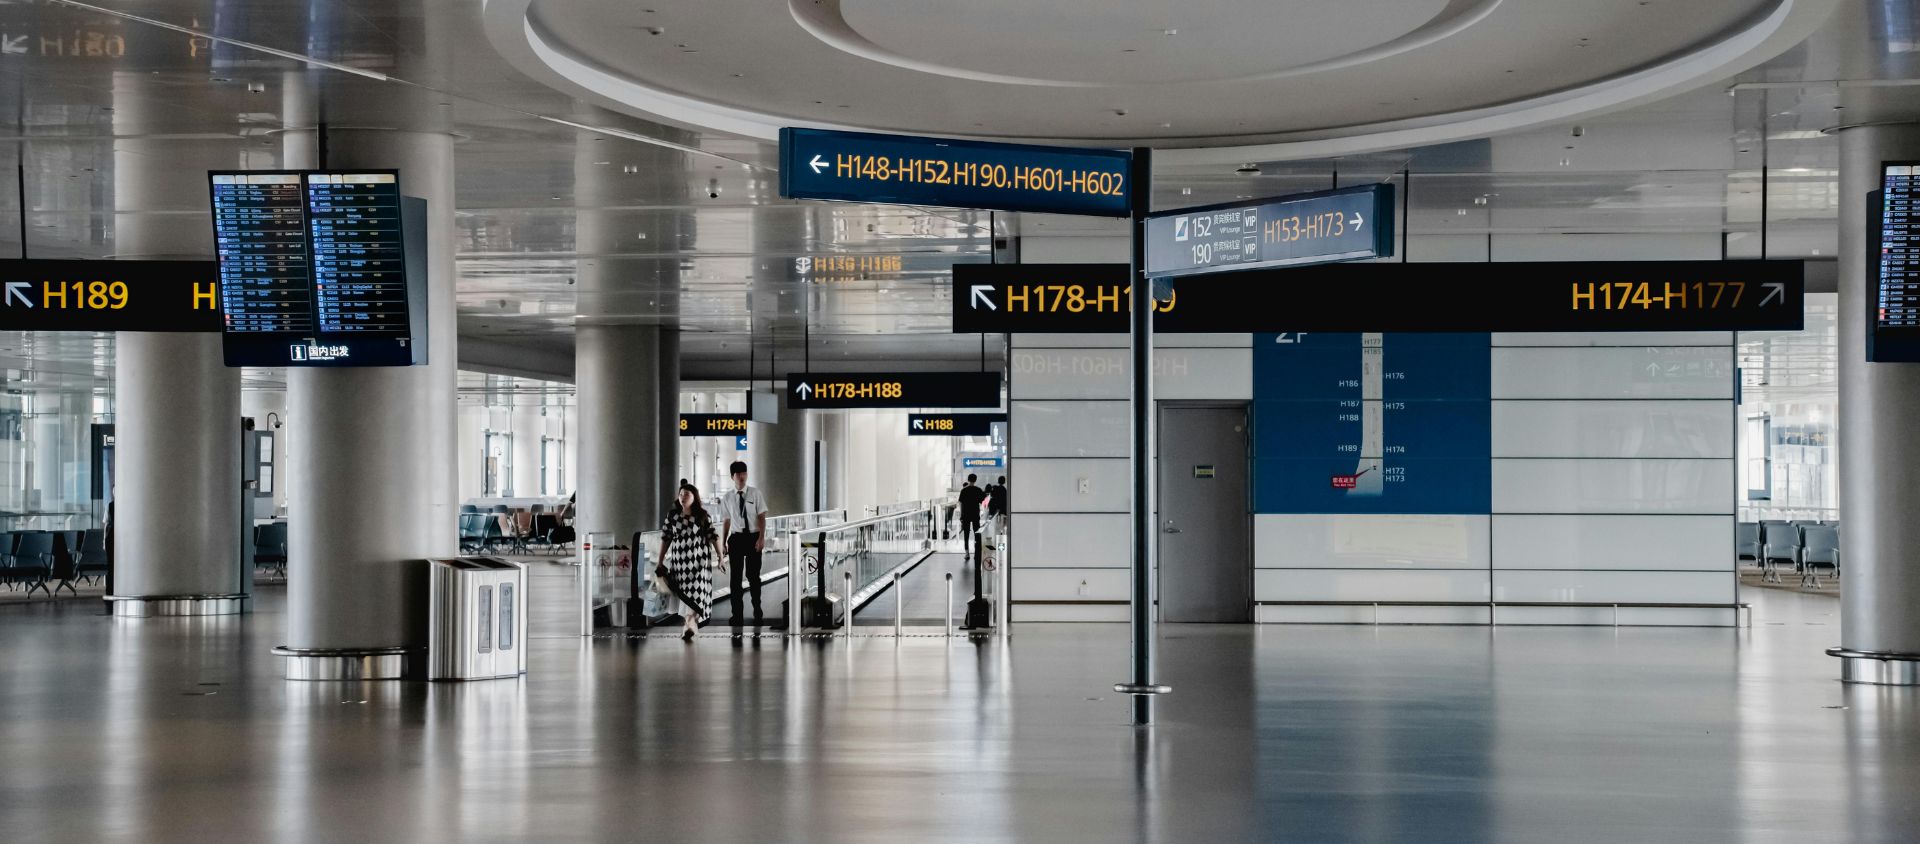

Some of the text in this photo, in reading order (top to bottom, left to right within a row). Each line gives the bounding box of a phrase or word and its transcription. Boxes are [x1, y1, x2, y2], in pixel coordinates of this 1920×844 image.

[1192, 216, 1211, 238] 152
[1245, 216, 1256, 227] VIP
[1264, 212, 1344, 244] H153-H173
[1192, 243, 1211, 265] 190
[1245, 243, 1256, 255] VIP
[43, 281, 129, 309] H189
[1007, 285, 1176, 313] H178-H19
[1572, 282, 1746, 310] H174-H177
[309, 345, 349, 357] 国内出发
[814, 382, 902, 398] H178-H188
[925, 419, 954, 430] H188
